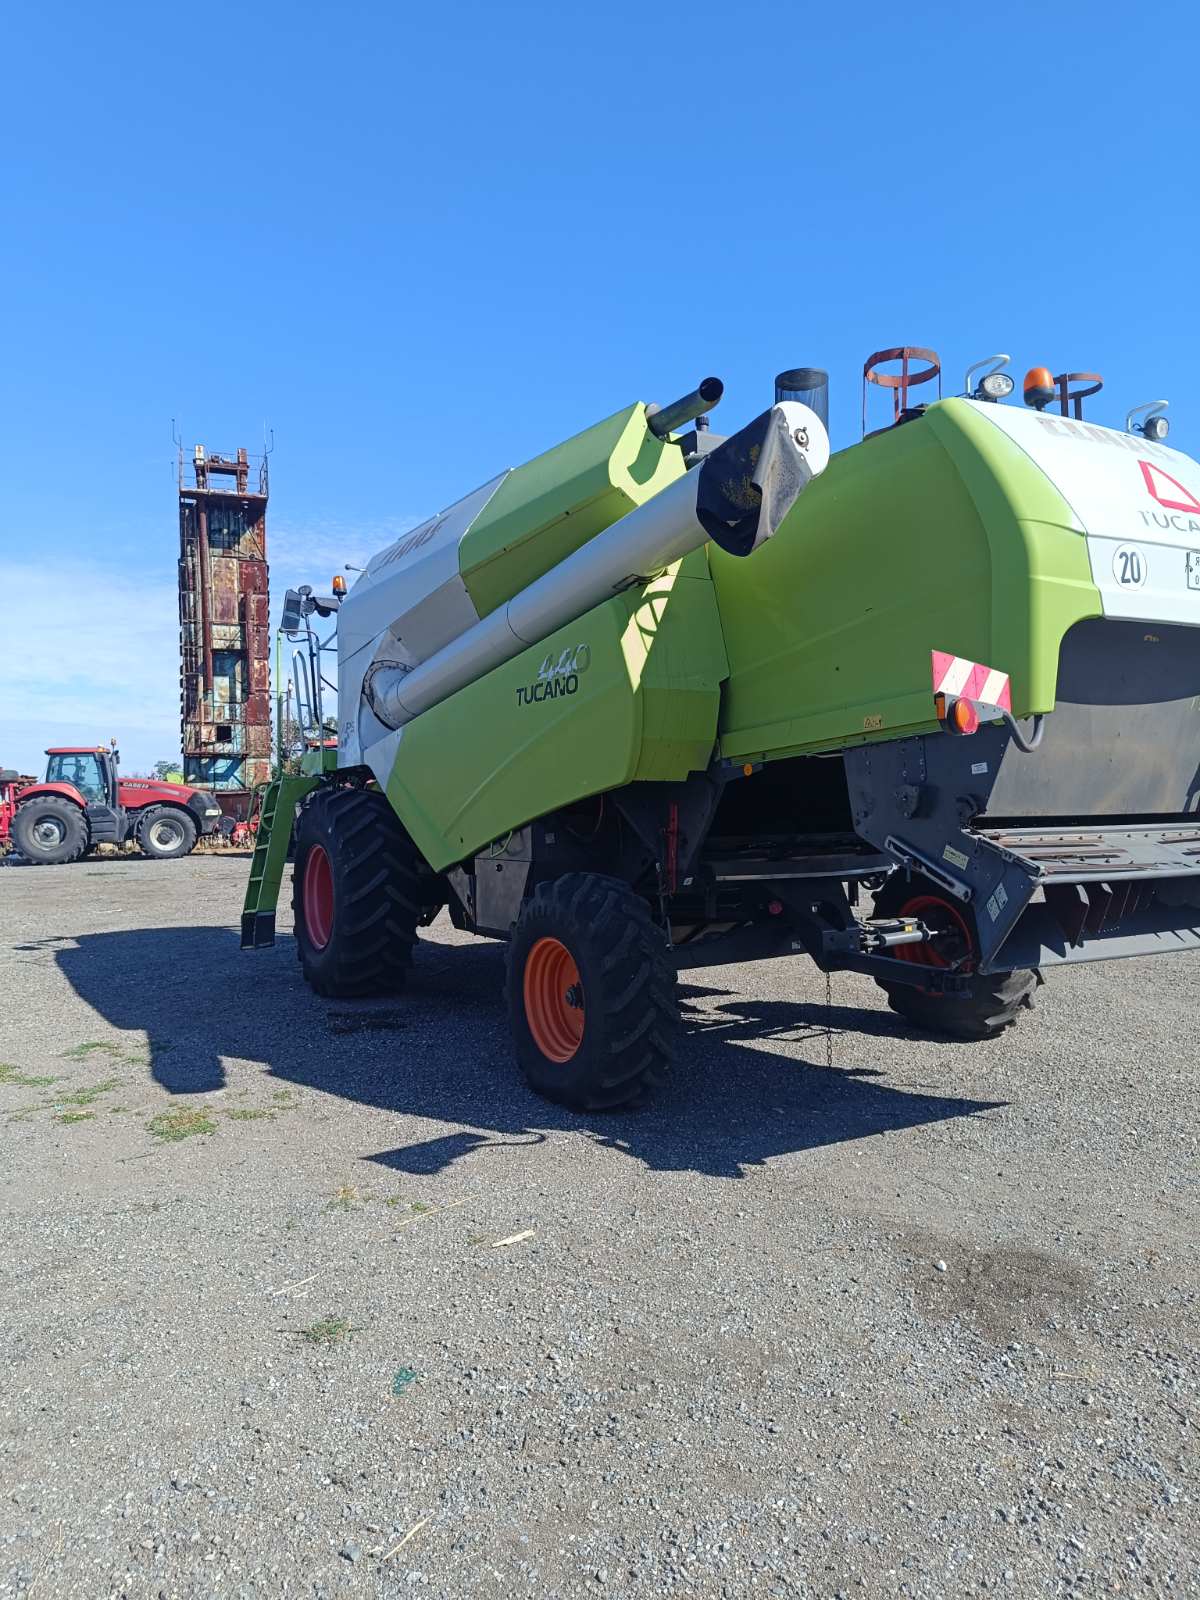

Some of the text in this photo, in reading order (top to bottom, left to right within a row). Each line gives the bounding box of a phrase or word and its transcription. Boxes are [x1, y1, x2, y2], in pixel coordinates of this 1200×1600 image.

[1119, 551, 1141, 584] 20
[537, 643, 591, 680] 440
[516, 674, 579, 706] TUCANO
